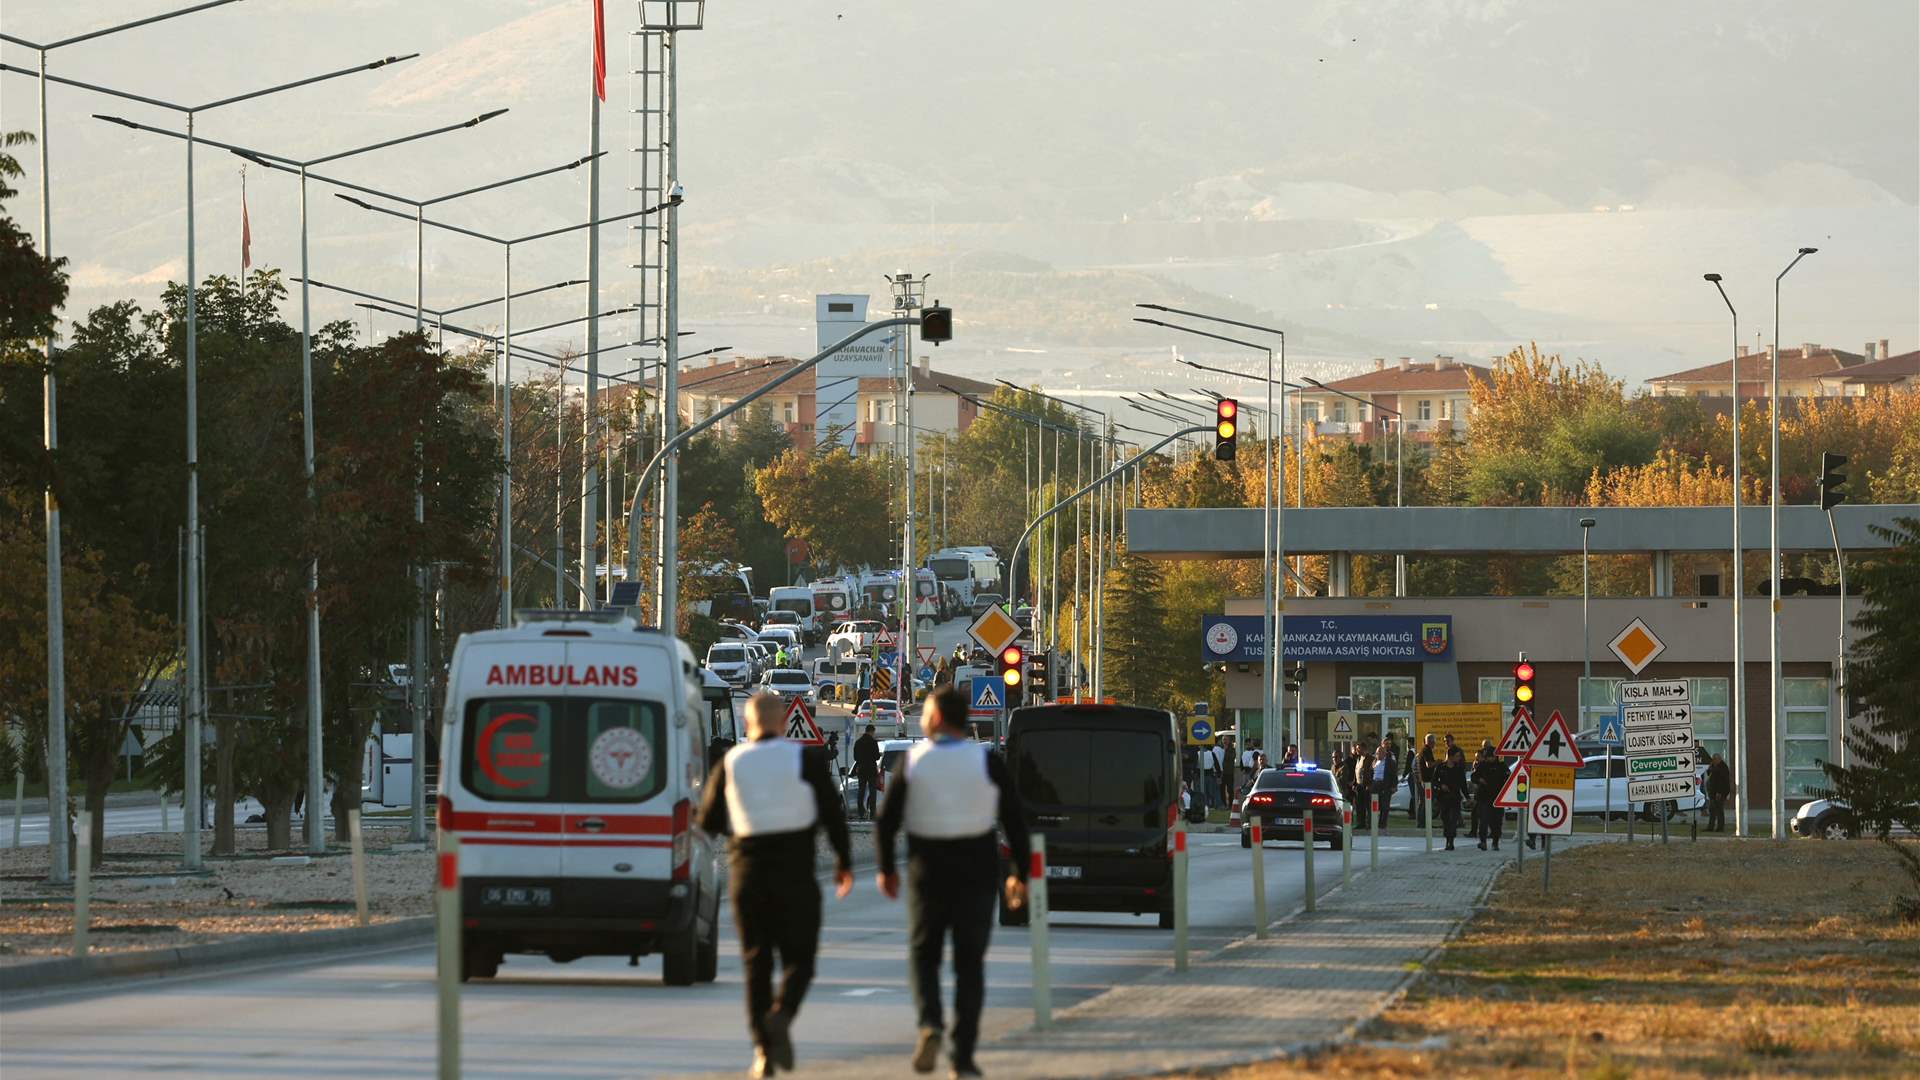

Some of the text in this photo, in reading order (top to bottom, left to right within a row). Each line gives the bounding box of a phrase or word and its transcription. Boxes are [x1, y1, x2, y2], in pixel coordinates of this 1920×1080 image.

[1320, 620, 1338, 630] T.C.
[1246, 632, 1413, 643] KAHMANKAZAN KAYMAKAMLIĞI
[1283, 646, 1334, 656] ANDARMA
[1372, 646, 1416, 656] NOKTASI
[486, 664, 639, 687] AMBULANS
[1624, 687, 1673, 699] KIŞLA MAH.
[1658, 710, 1675, 720] MAH.
[1658, 732, 1676, 745] ÜSSÜ
[1631, 758, 1676, 772] Çevreyolu
[1661, 783, 1679, 794] KAZAN
[1541, 804, 1561, 819] 30
